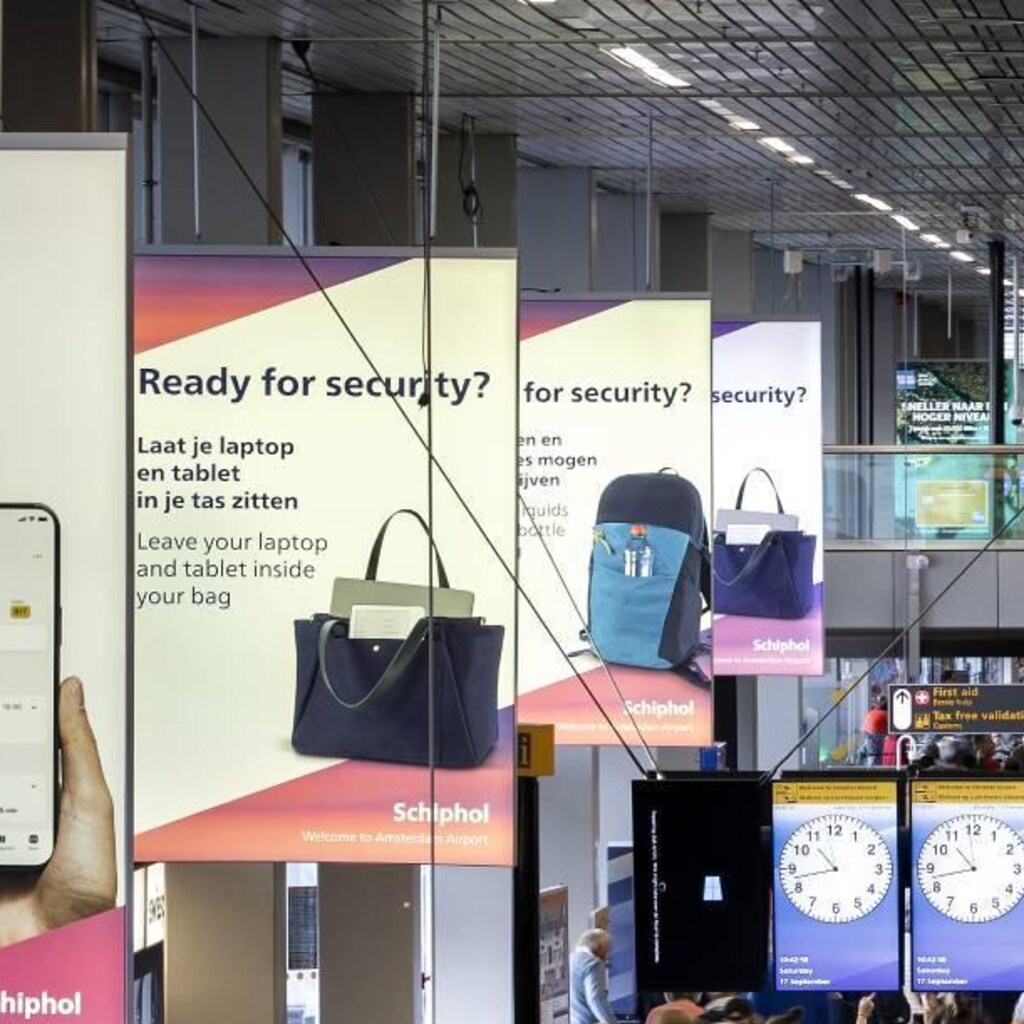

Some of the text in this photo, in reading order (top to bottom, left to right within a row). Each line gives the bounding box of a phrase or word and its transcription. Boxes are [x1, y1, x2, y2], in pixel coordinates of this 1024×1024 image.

[139, 367, 250, 403] Ready
[262, 368, 315, 396] for
[526, 382, 692, 408] for security?
[712, 386, 806, 408] security?
[542, 436, 562, 446] en
[138, 437, 294, 460] Laat je laptop
[538, 456, 597, 470] mogen
[137, 464, 240, 482] en tablet
[137, 492, 298, 514] in je tas zitten
[138, 533, 328, 557] Leave your laptop
[137, 561, 315, 579] and tablet inside
[137, 588, 231, 608] your bag
[753, 638, 810, 655] Schiphol
[933, 687, 978, 696] First aid
[624, 700, 694, 717] Schiphol
[934, 711, 951, 719] Tax
[956, 710, 978, 719] free
[393, 802, 489, 825] Schiphol
[828, 825, 842, 836] 12
[946, 830, 958, 841] 11
[966, 825, 980, 835] 12
[990, 830, 996, 841] 1
[302, 830, 354, 842] Welcome
[359, 832, 372, 842] to
[447, 833, 488, 846] Airport
[808, 831, 820, 841] 11
[852, 831, 858, 841] 1
[795, 845, 809, 855] 10
[868, 845, 876, 855] 2
[933, 844, 947, 855] 10
[1006, 844, 1014, 854] 2
[789, 864, 797, 874] 9
[875, 864, 883, 874] 3
[927, 863, 935, 874] 9
[1013, 864, 1021, 874] 3
[795, 883, 803, 893] 8
[867, 884, 875, 894] 4
[933, 882, 941, 892] 8
[1005, 883, 1013, 893] 4
[809, 897, 817, 907] 7
[854, 898, 862, 908] 5
[947, 896, 955, 907] 7
[992, 897, 1000, 908] 5
[832, 903, 840, 914] 6
[970, 903, 978, 913] 6
[0, 990, 80, 1020] hiphol
